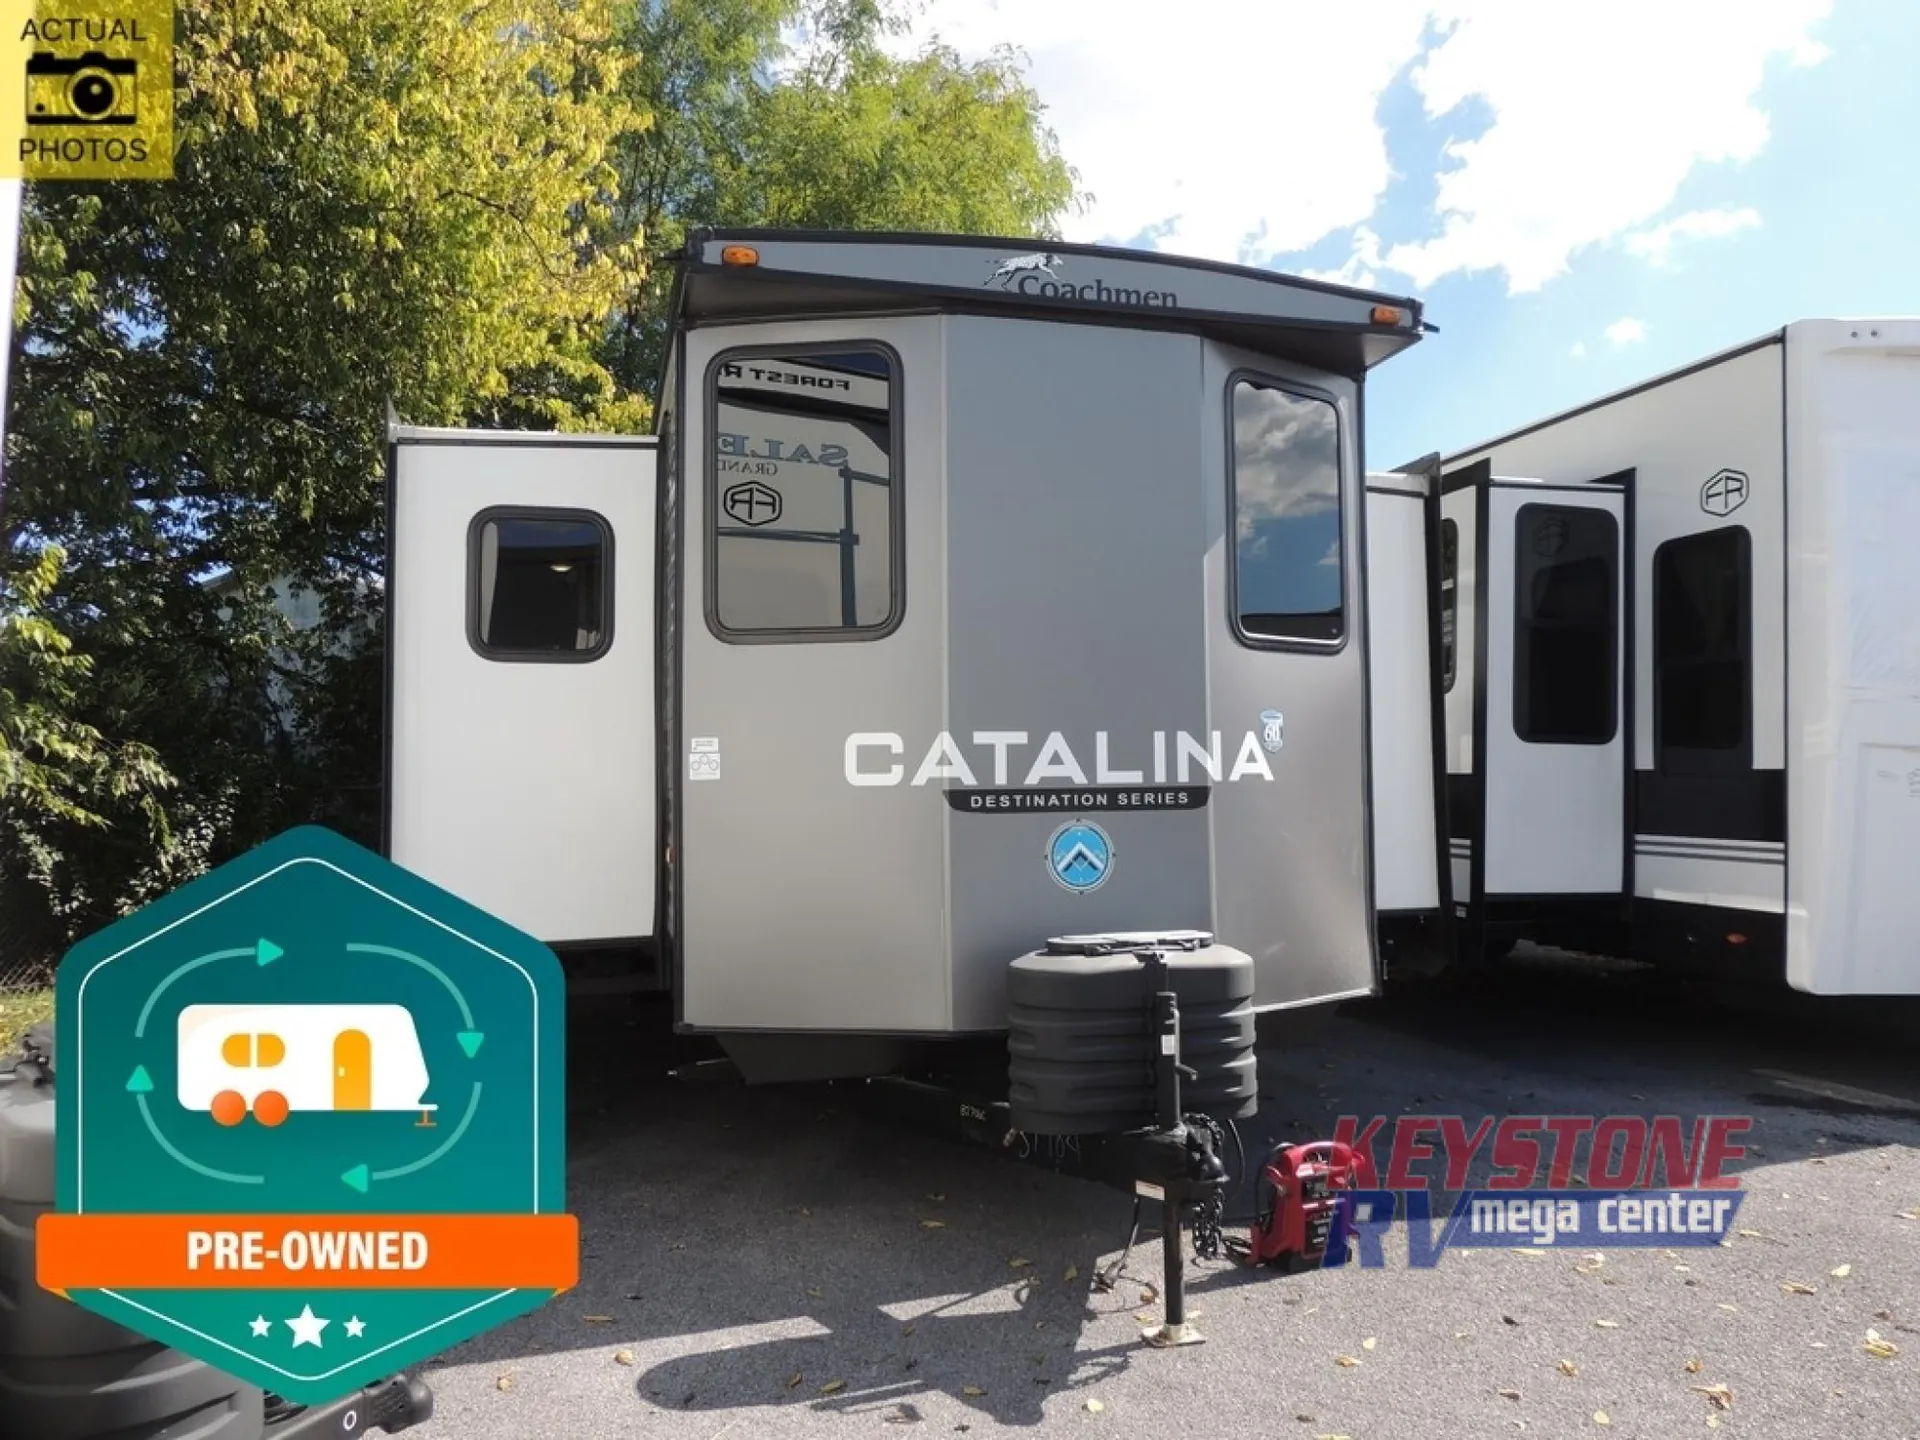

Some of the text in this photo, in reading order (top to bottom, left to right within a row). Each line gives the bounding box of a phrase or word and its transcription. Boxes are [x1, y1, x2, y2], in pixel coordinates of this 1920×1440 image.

[1017, 274, 1178, 308] Coachmen
[844, 730, 1275, 787] CATALINA
[970, 791, 1189, 808] DESTINATION SERIES
